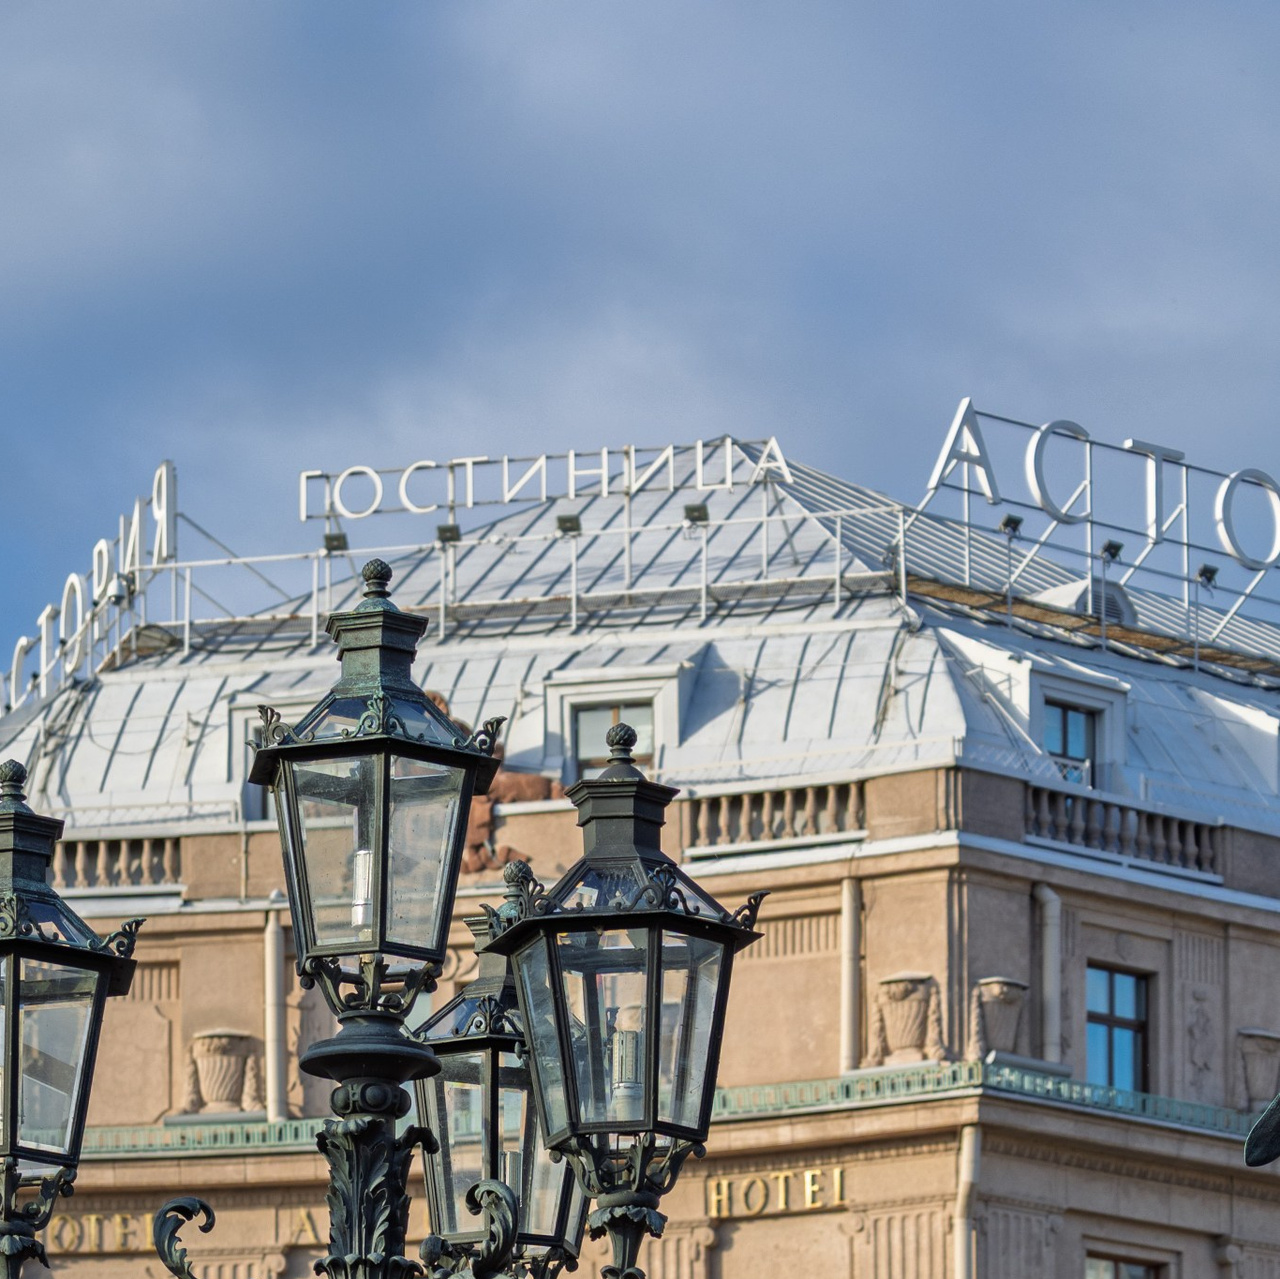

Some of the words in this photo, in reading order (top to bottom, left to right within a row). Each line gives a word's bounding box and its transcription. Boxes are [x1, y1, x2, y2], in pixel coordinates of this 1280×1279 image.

[300, 436, 794, 522] ГОСТИНИЦА
[926, 396, 1280, 571] АСТО
[708, 1167, 846, 1218] HOTEL
